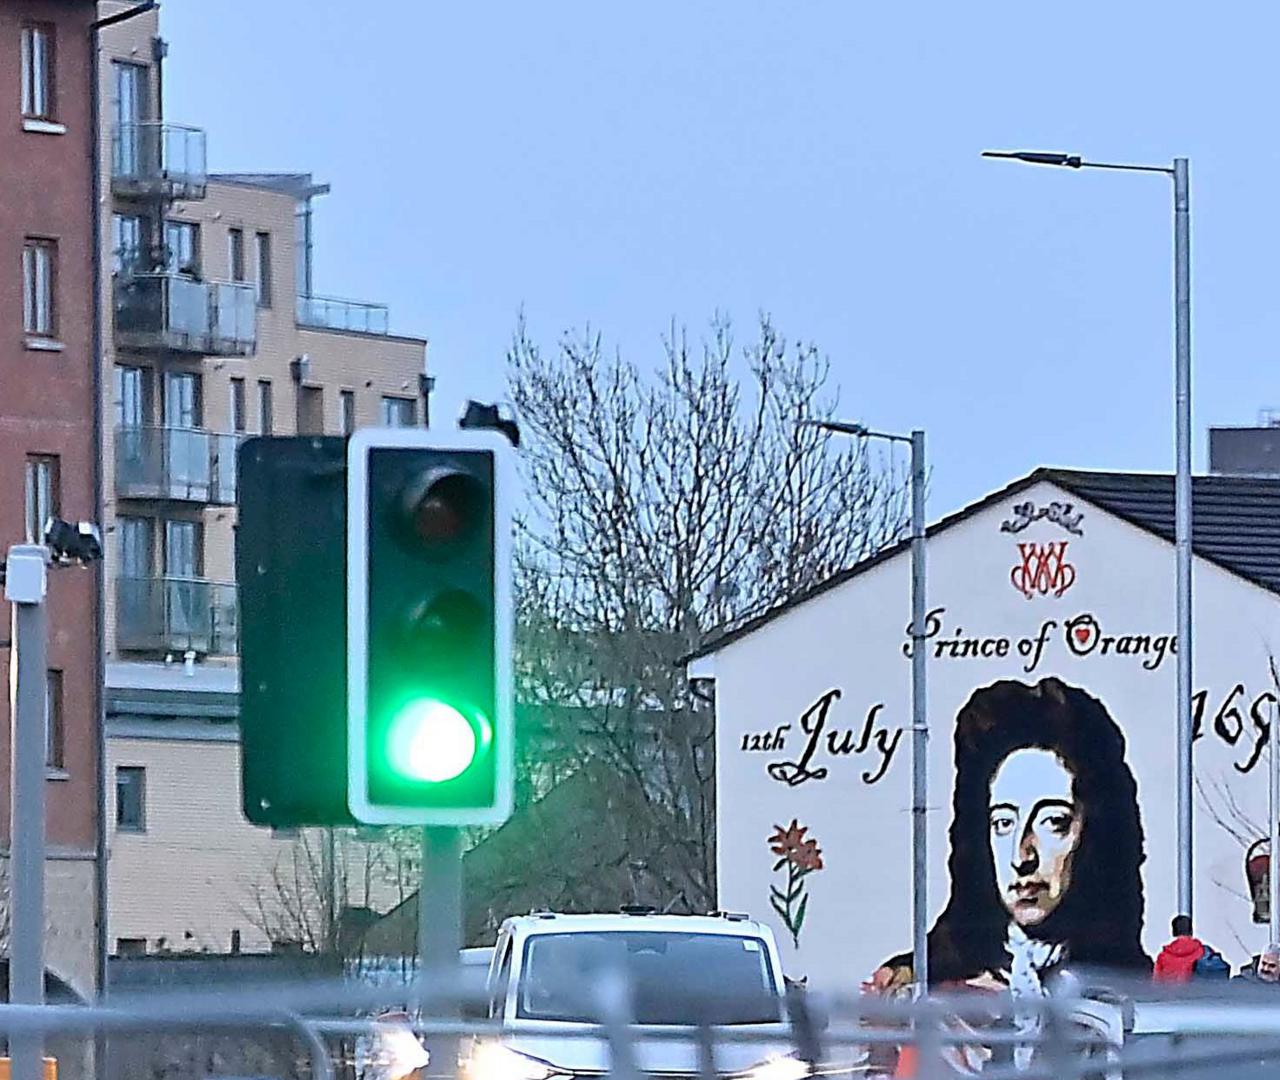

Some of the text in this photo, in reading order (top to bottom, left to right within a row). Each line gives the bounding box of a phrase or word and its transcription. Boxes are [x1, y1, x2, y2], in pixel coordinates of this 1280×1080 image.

[902, 608, 1009, 660] Prince
[1017, 621, 1057, 673] of
[741, 689, 904, 787] 12th July
